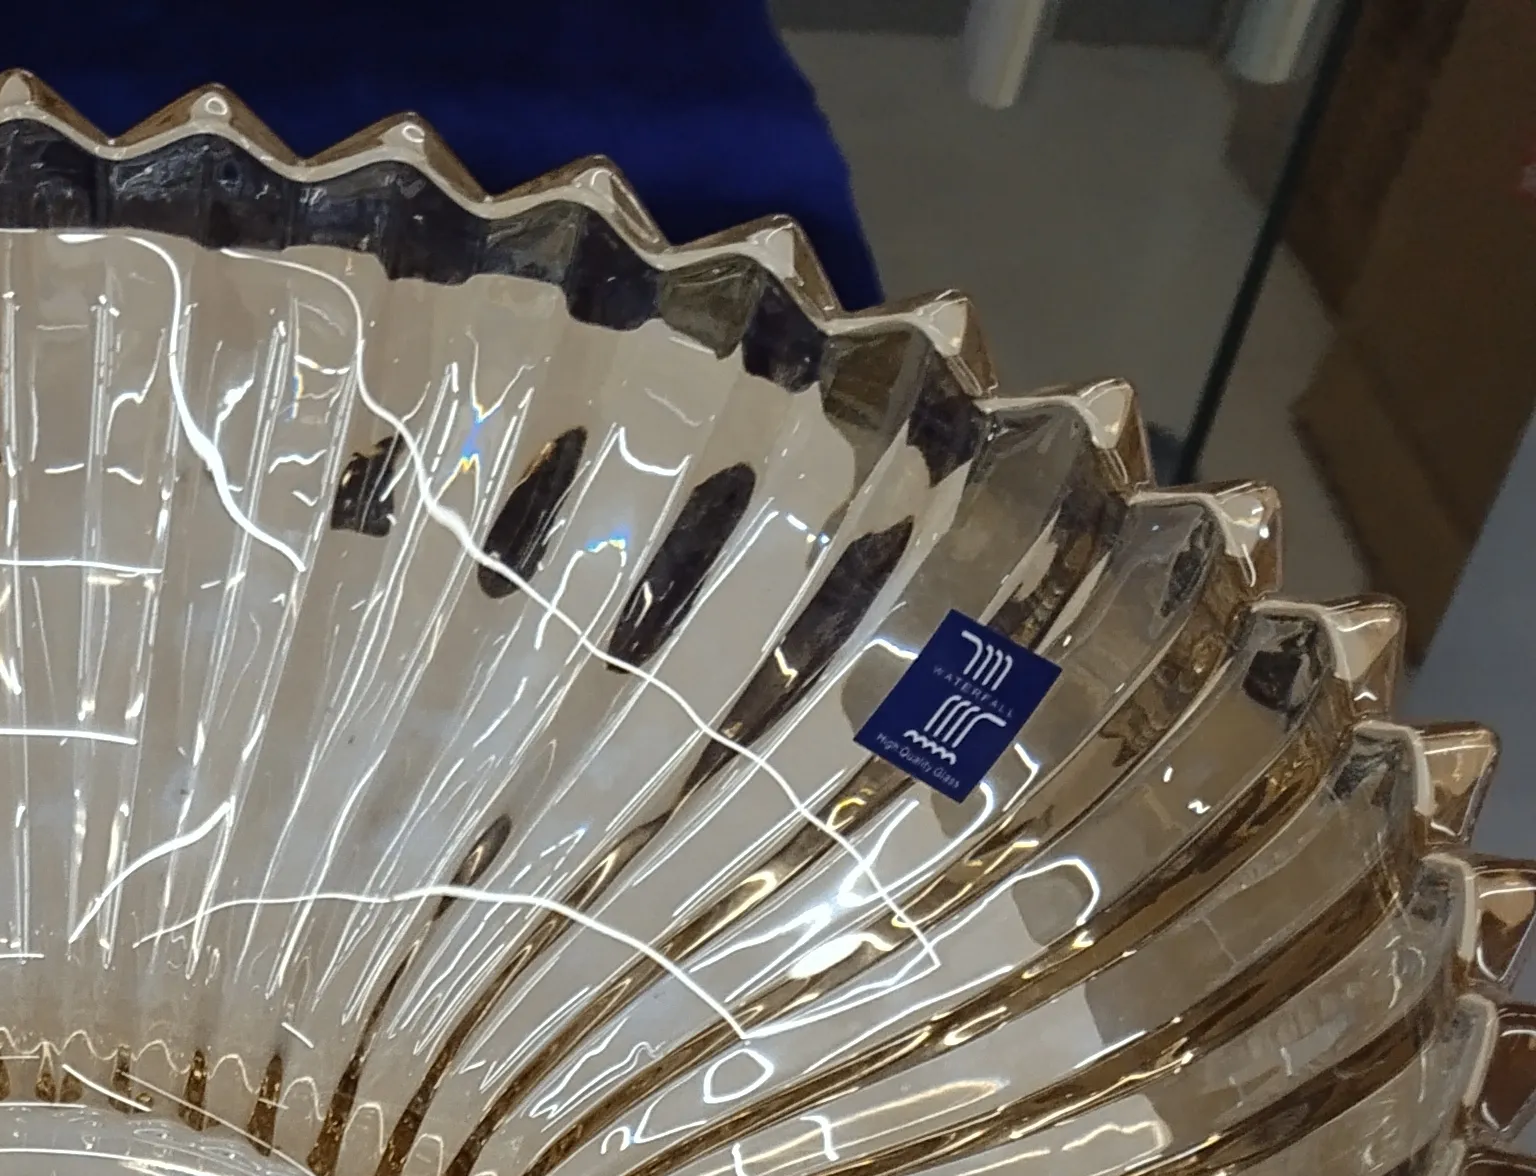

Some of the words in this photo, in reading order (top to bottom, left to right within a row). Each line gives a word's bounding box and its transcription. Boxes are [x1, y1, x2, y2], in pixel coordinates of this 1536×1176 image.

[933, 664, 1014, 719] WATERFALL
[875, 732, 899, 752] High
[898, 746, 932, 773] Quality
[933, 766, 961, 789] Glass
